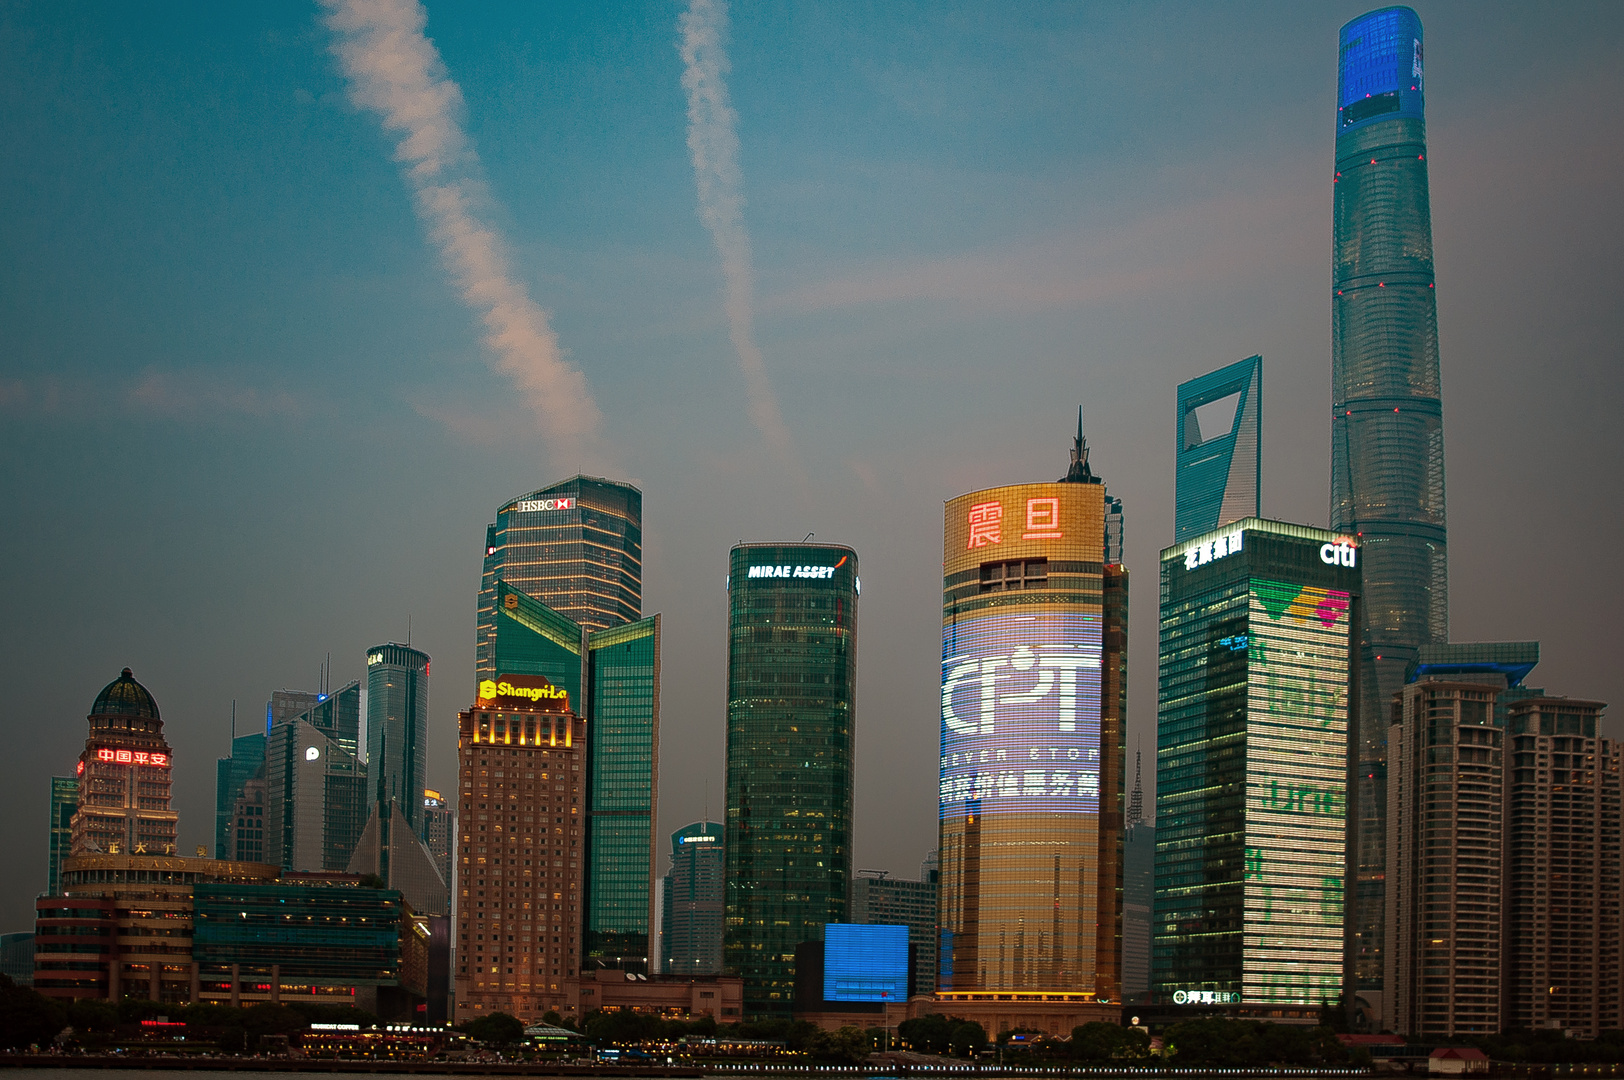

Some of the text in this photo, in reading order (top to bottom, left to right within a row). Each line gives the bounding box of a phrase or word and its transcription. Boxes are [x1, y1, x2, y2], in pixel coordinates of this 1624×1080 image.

[521, 499, 554, 512] HSBC
[967, 497, 1063, 550] 震旦
[1319, 538, 1356, 568] citi
[748, 565, 835, 578] MIRAE ASSET
[497, 681, 567, 701] Shangri-La
[98, 748, 167, 766] 中国平安
[940, 748, 1099, 768] NEVER STOP
